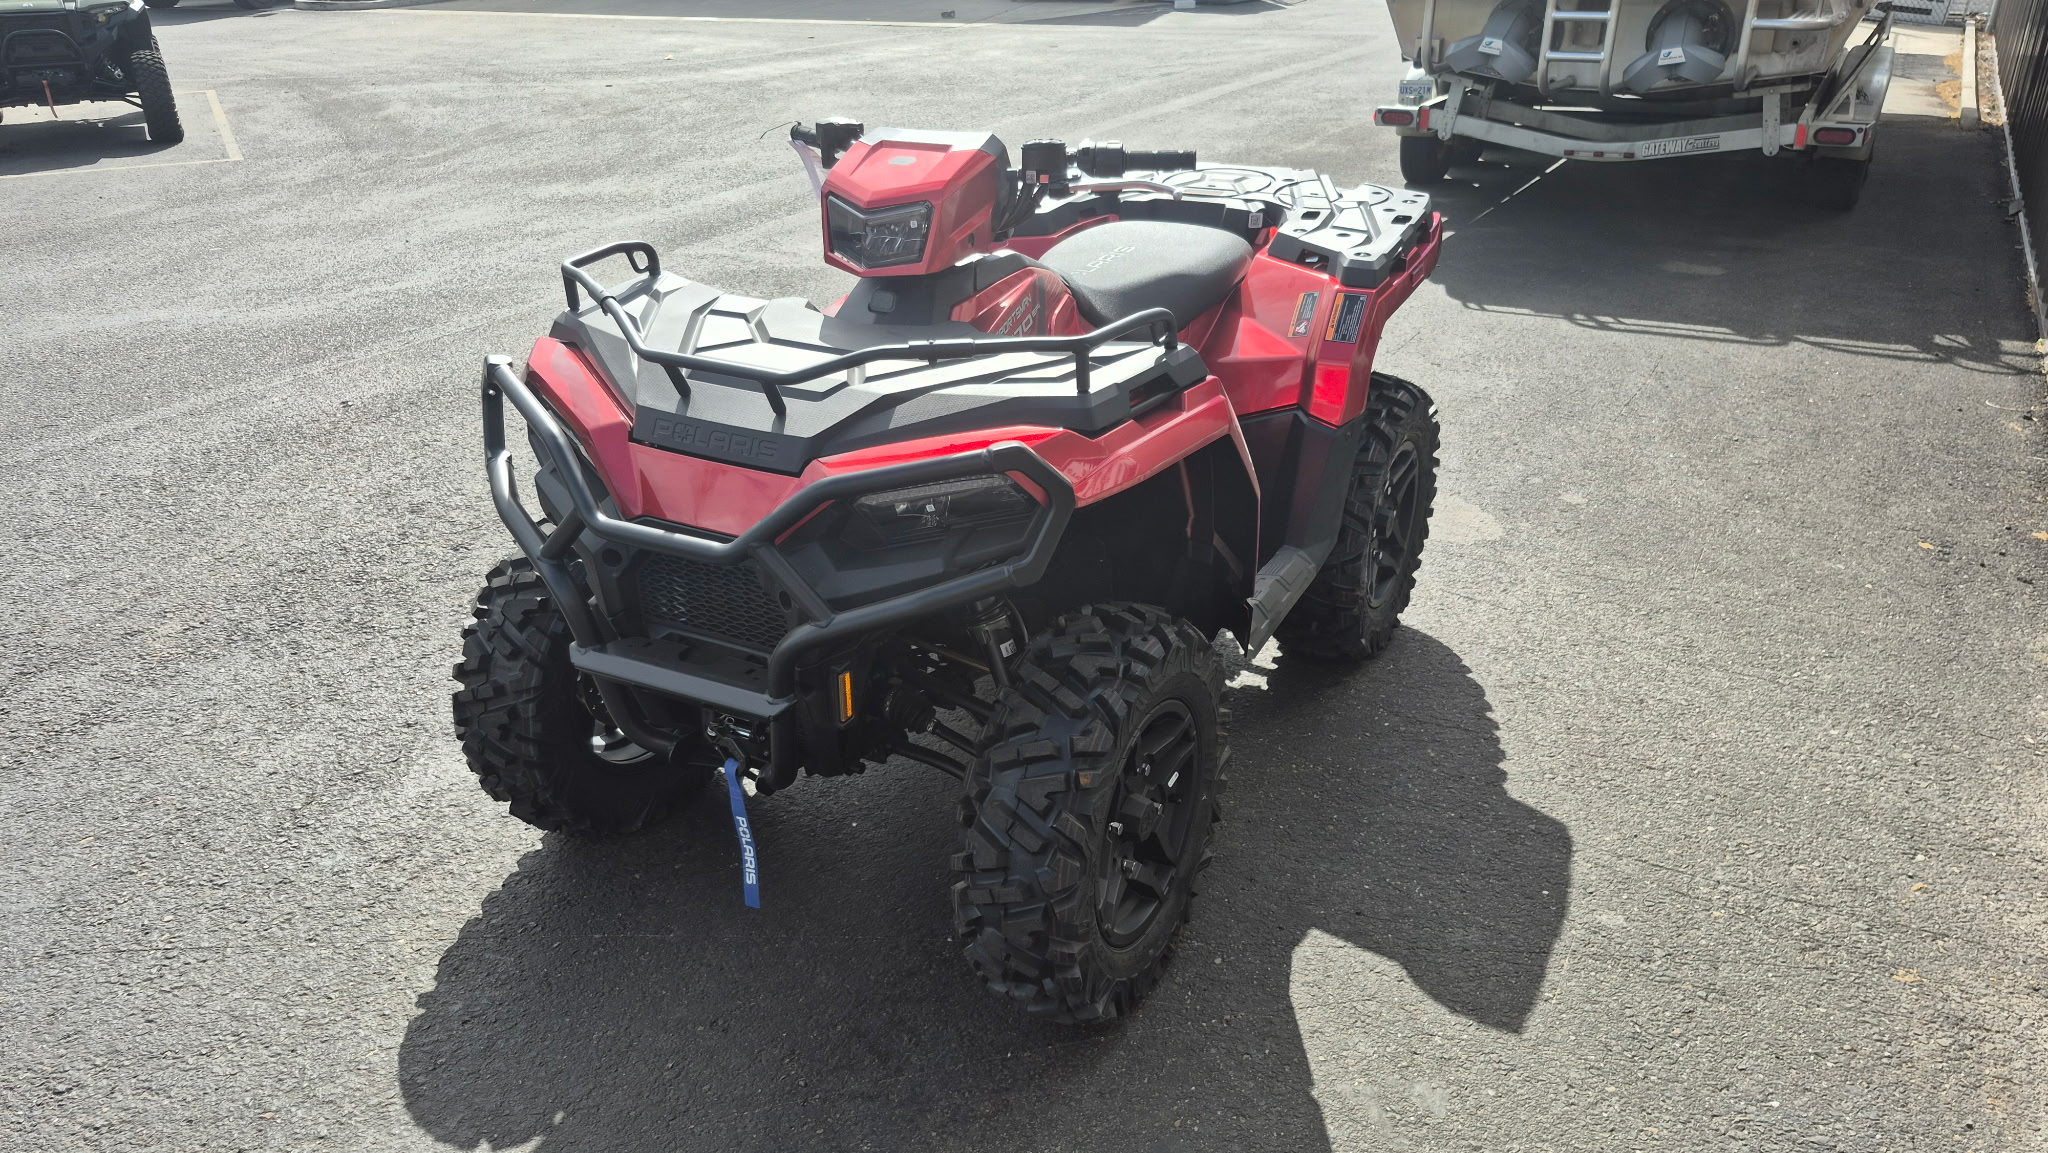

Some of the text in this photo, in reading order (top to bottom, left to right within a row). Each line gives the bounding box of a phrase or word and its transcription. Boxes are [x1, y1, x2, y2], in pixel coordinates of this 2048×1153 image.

[1641, 139, 1688, 157] GATEWAY
[996, 292, 1032, 335] PORTSMAN
[653, 417, 780, 462] POLARIS
[736, 815, 757, 885] POLARIS
